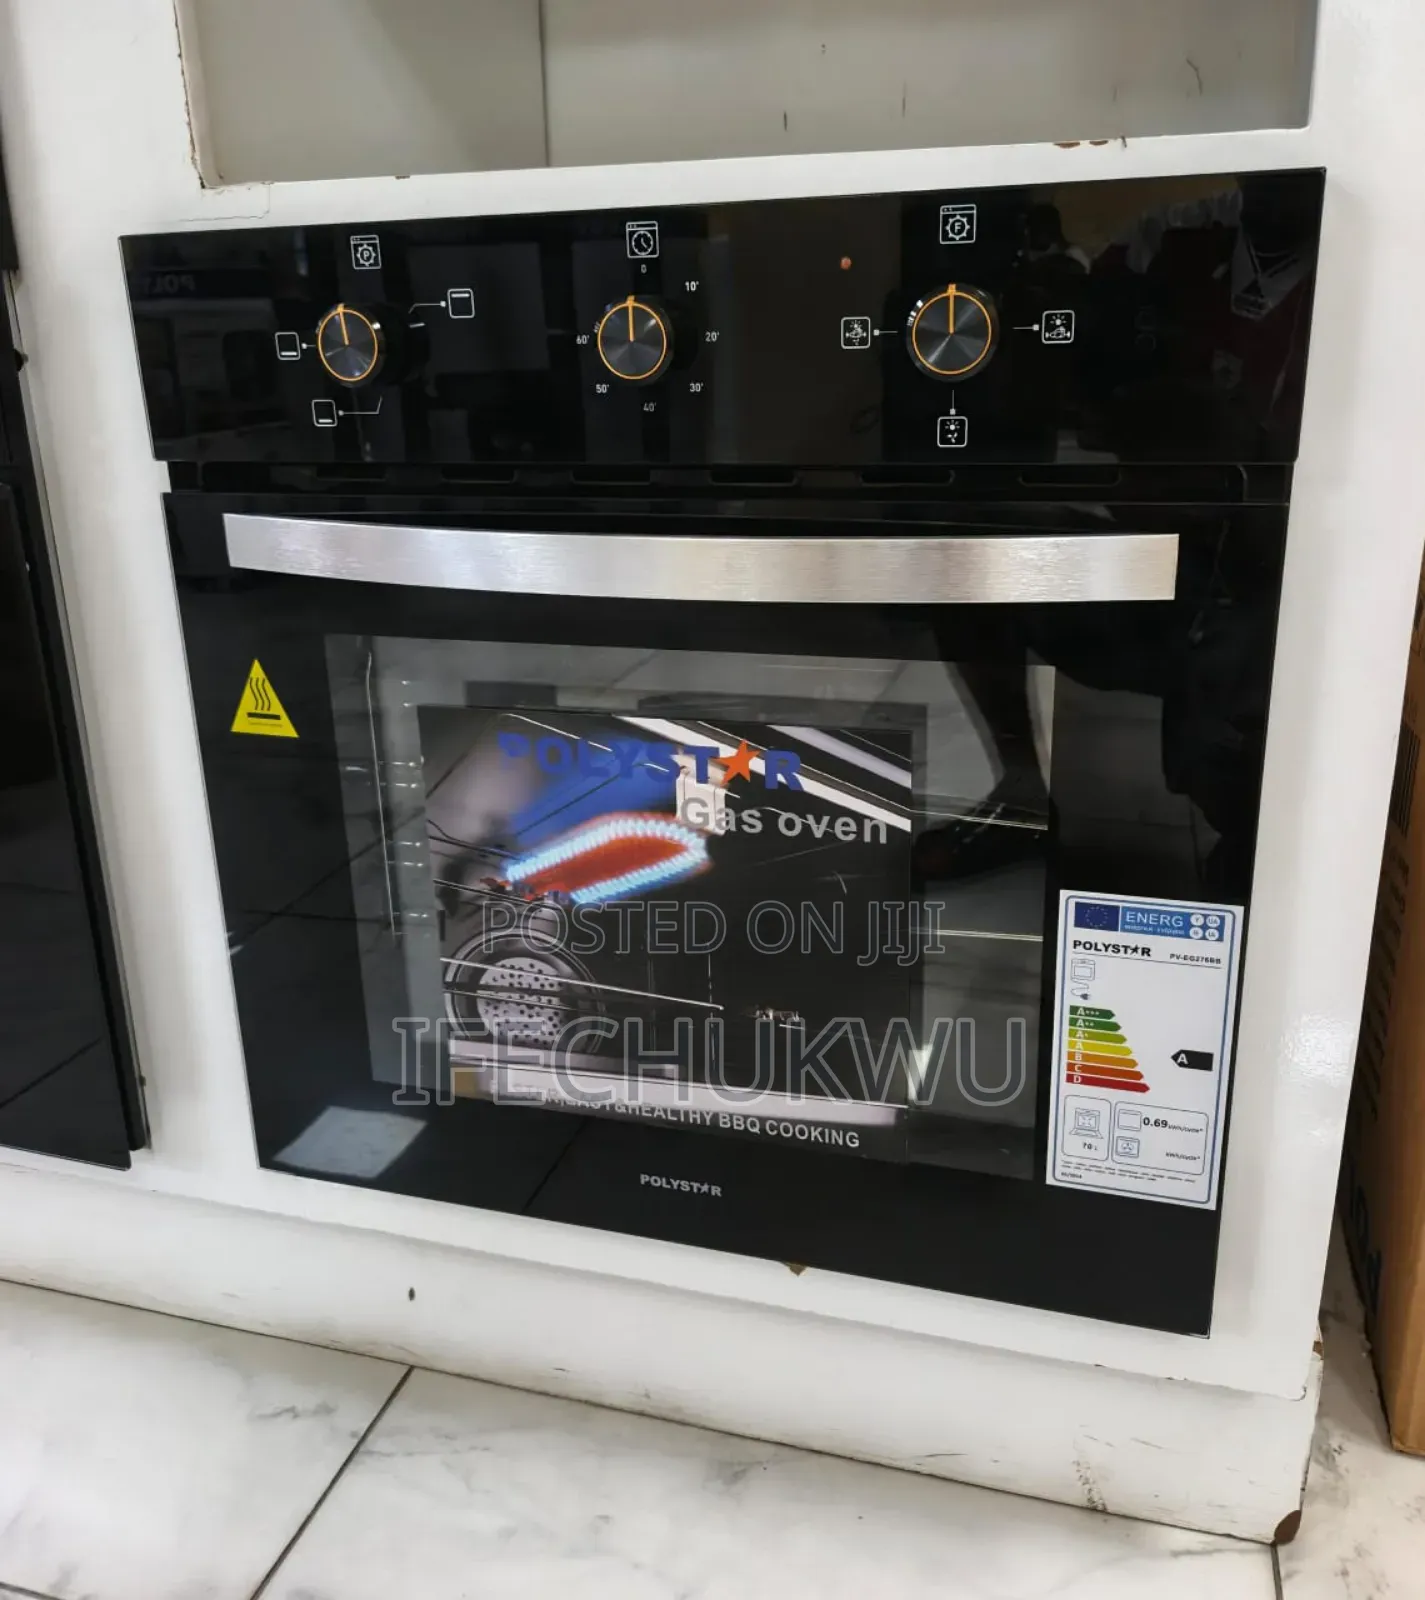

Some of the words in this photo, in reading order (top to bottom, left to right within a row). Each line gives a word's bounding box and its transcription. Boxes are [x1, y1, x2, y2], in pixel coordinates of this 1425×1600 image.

[954, 221, 962, 234] F
[363, 250, 370, 261] P
[680, 796, 764, 838] Gas
[778, 807, 888, 845] oven
[1125, 911, 1184, 927] ENERG
[1075, 1042, 1083, 1050] A
[1074, 1053, 1082, 1061] B
[1176, 1054, 1188, 1065] A
[1074, 1064, 1082, 1072] C
[1073, 1075, 1082, 1083] D
[1143, 1117, 1168, 1128] 0.69
[718, 1111, 761, 1134] BBQ
[765, 1119, 860, 1148] COOKING
